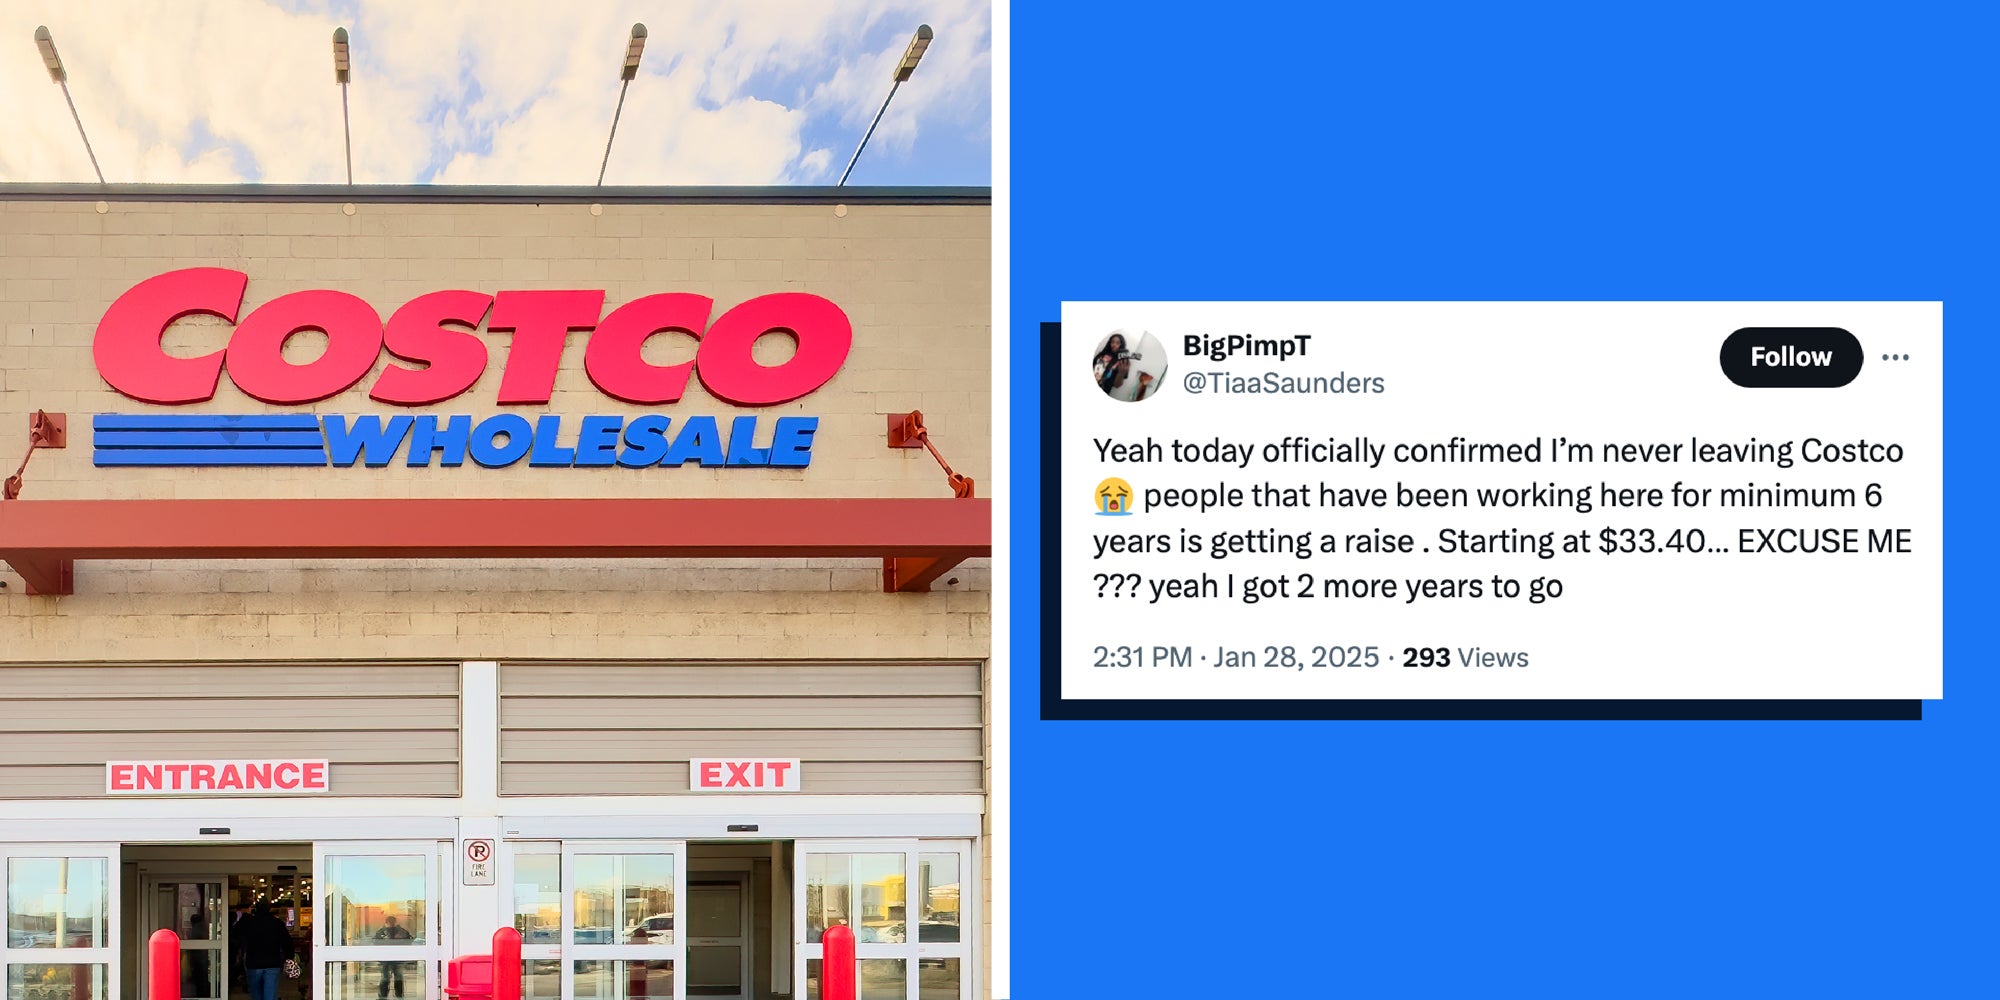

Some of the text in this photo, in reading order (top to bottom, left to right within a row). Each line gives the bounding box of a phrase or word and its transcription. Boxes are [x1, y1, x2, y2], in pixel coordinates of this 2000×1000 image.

[92, 267, 853, 408] COSTCO
[322, 413, 819, 468] WHOLESALE
[111, 762, 325, 790] ENTRANCE
[700, 762, 791, 787] EXIT
